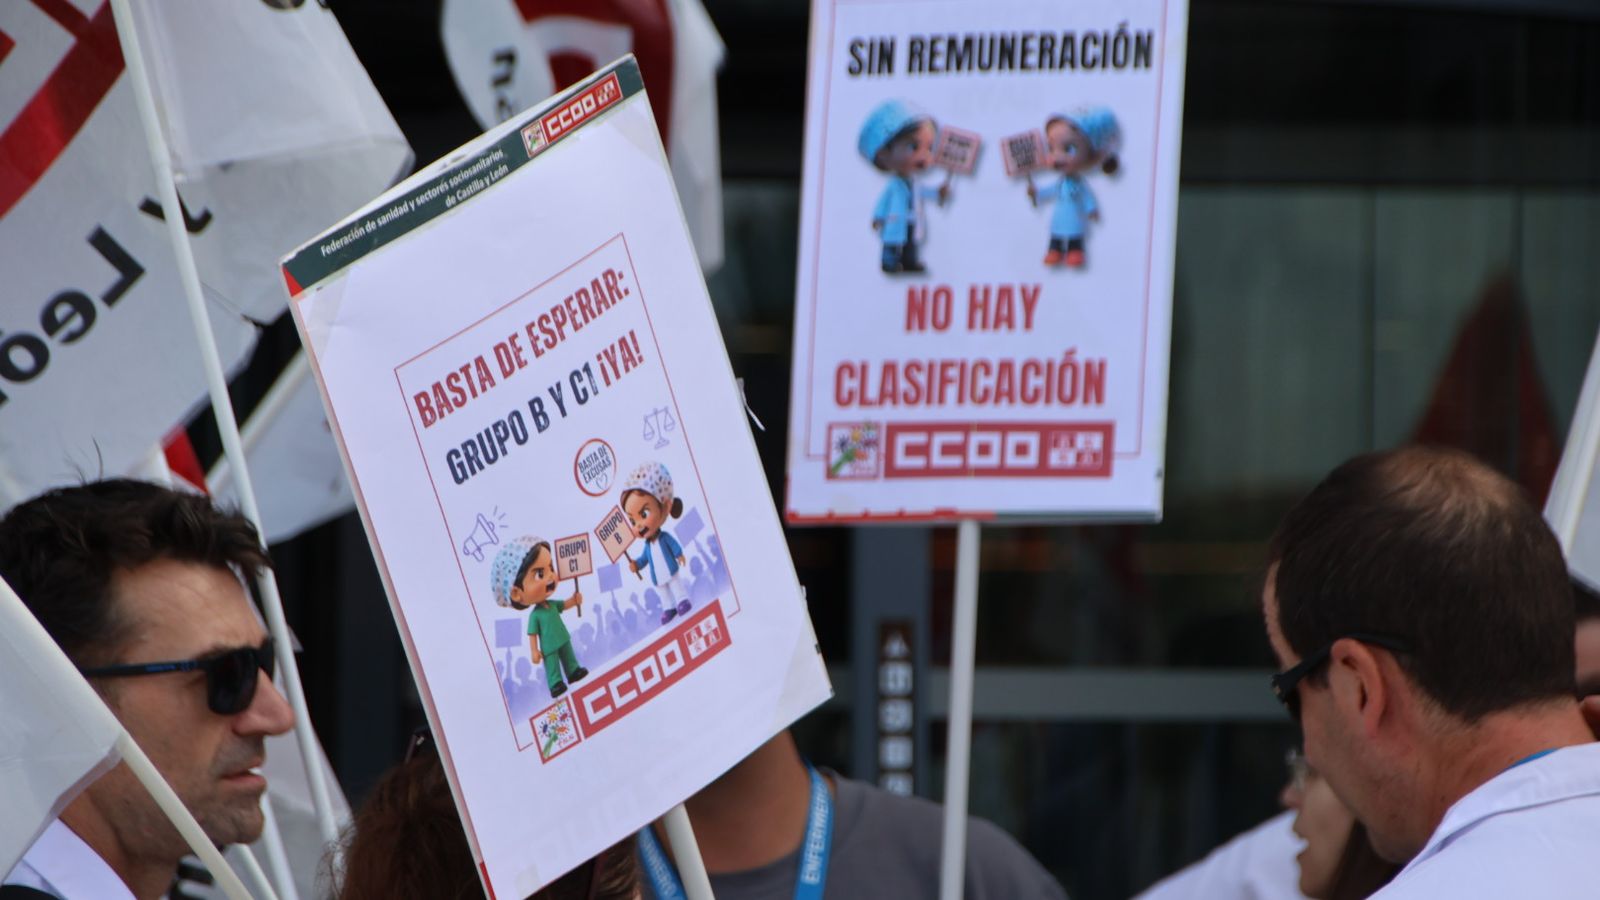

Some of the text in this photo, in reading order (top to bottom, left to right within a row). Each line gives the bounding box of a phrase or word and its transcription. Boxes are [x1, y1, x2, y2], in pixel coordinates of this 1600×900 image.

[848, 22, 1154, 75] SIN REMUNERACIÓN
[546, 93, 597, 137] CCOO
[321, 149, 504, 257] Federación de sanidad y sectores sociosanitarios
[445, 163, 509, 208] de Castilla y León
[904, 284, 1042, 332] NO HAY
[413, 267, 630, 429] BASTA DE ESPERAR:
[833, 347, 1107, 408] CLASIFICACIÓN
[446, 329, 645, 485] GRUPO B Y C1 ¡YA!
[578, 444, 607, 474] BASTA DE
[582, 456, 612, 484] EXCUSAS
[894, 431, 1041, 469] CCOO
[599, 511, 623, 541] GRUPO
[614, 532, 623, 545] B
[559, 540, 586, 559] GRUPO
[568, 558, 579, 573] C1
[582, 639, 686, 725] CCOO
